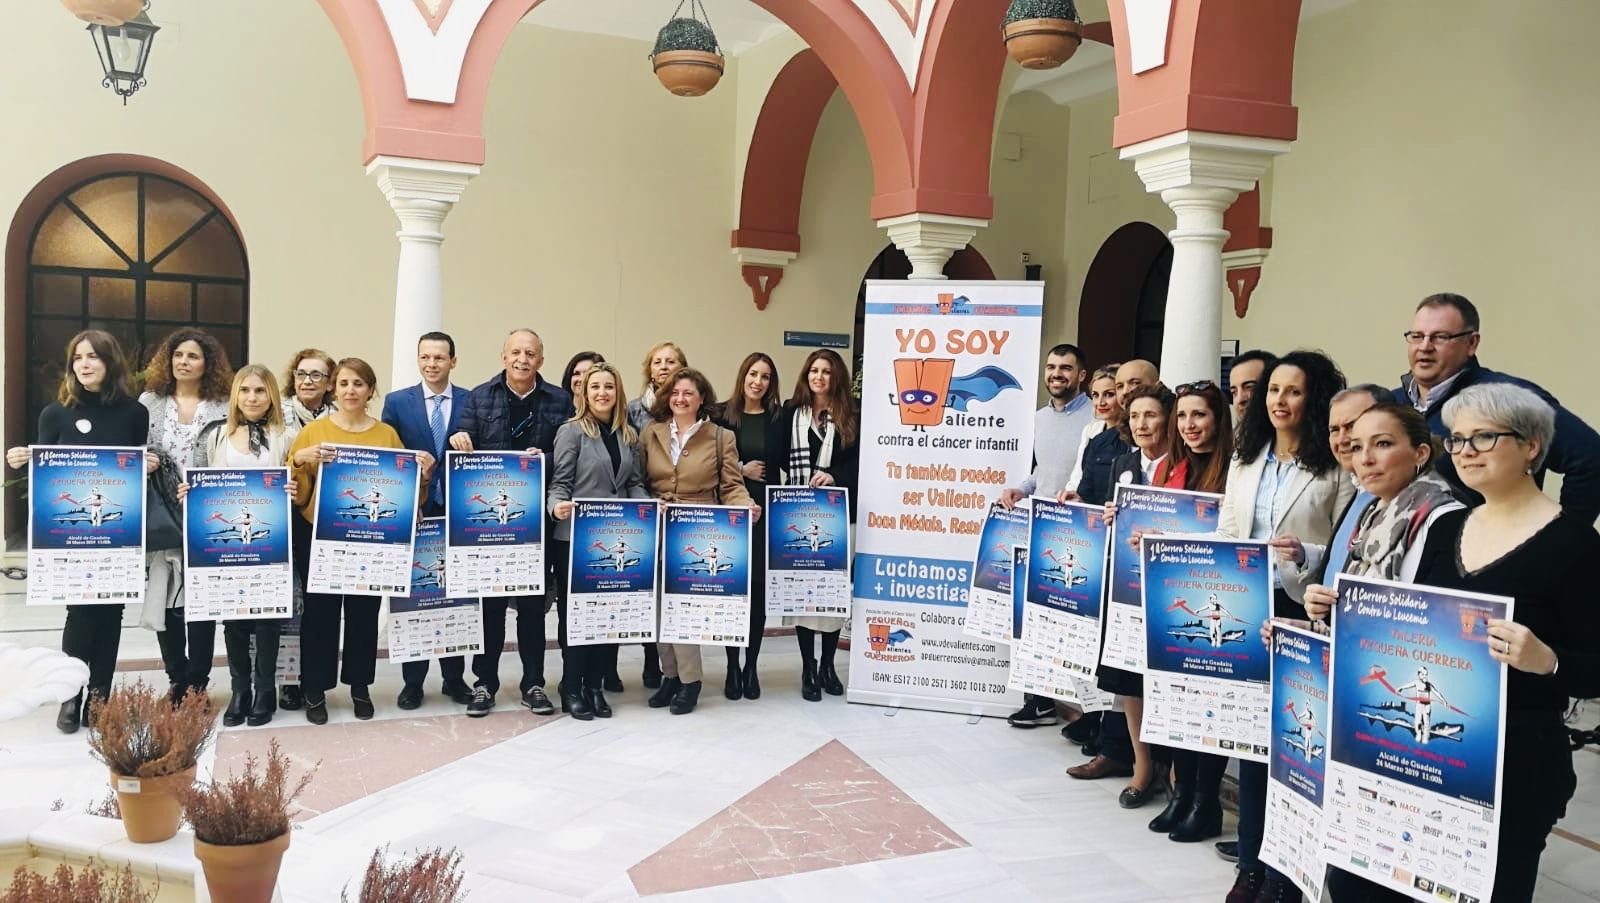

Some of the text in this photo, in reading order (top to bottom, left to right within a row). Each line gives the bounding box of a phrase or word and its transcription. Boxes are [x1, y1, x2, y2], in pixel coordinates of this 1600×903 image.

[895, 329, 1010, 355] YO SOY
[878, 434, 1019, 451] contra el cáncer infantil
[886, 462, 1006, 485] Tu también puedes
[903, 488, 985, 509] ser Valiente
[867, 512, 896, 529] Dona
[900, 513, 946, 533] Médula,
[1184, 544, 1214, 554] Solidaria
[875, 558, 967, 582] Luchamos
[890, 579, 968, 602] investiga
[1359, 588, 1388, 603] Carrera
[1389, 593, 1428, 610] Solidaria
[866, 617, 916, 629] PEQUEÑOS
[921, 612, 955, 625] Colabora
[1358, 602, 1429, 625] Contra la Leucemia
[921, 638, 996, 653] www.vdevalientes.com
[1391, 629, 1437, 648] VALERIA
[864, 651, 916, 663] GUERREROS
[1412, 648, 1473, 671] GUERRERA
[873, 671, 1006, 694] IBAN: ES17 2100 2571 3602 1018 7200
[1379, 752, 1399, 763] Alcalá
[1400, 757, 1409, 765] de
[1384, 761, 1404, 773] Marzo
